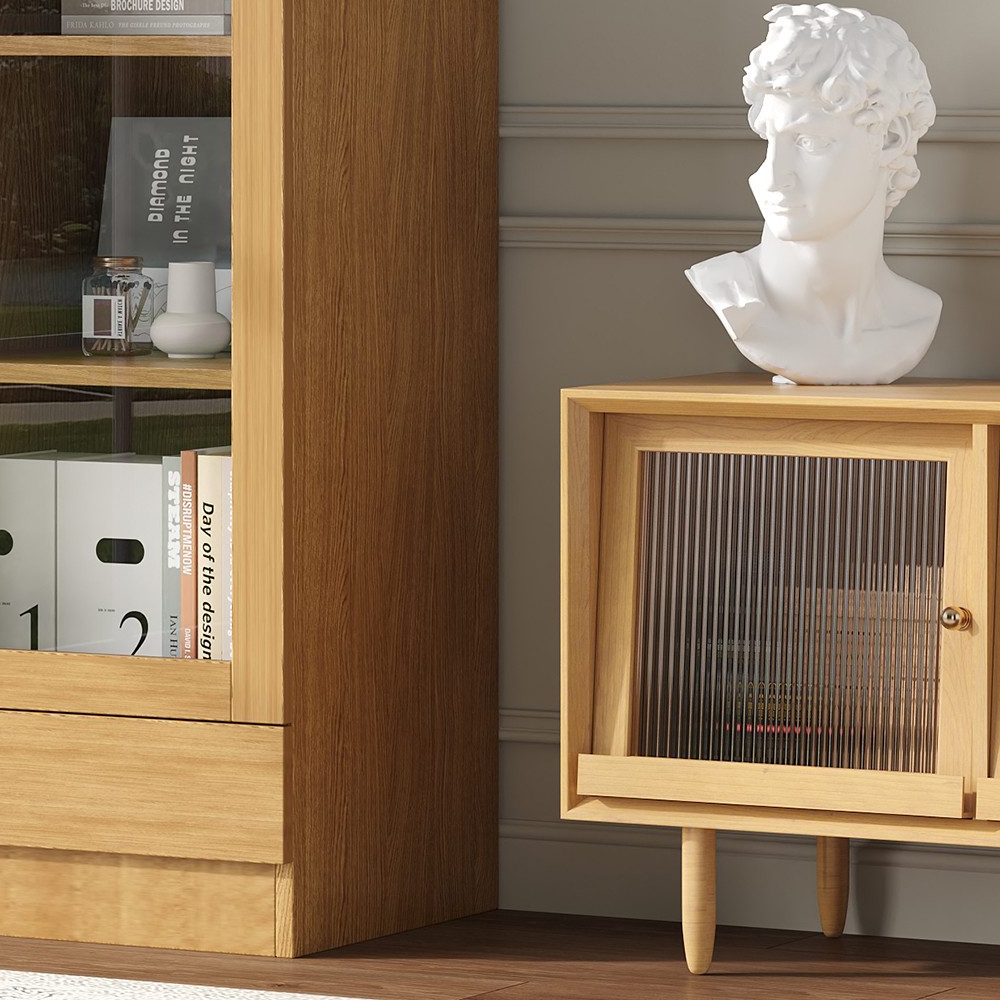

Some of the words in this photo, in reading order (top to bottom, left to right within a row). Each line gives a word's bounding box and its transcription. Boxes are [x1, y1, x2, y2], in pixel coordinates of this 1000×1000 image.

[110, 0, 153, 11] BROCHURE
[155, 0, 184, 11] DESIGN
[179, 135, 198, 184] NIGHT
[148, 148, 170, 222] DIAMOND
[175, 195, 192, 222] THE
[167, 470, 181, 569] STEAM
[182, 484, 192, 575] #DISRUPTMENOW
[200, 502, 214, 537] Day
[202, 542, 214, 564] of
[202, 566, 214, 595] the
[19, 604, 38, 650] 1
[120, 610, 149, 656] 2
[170, 615, 178, 636] IAN
